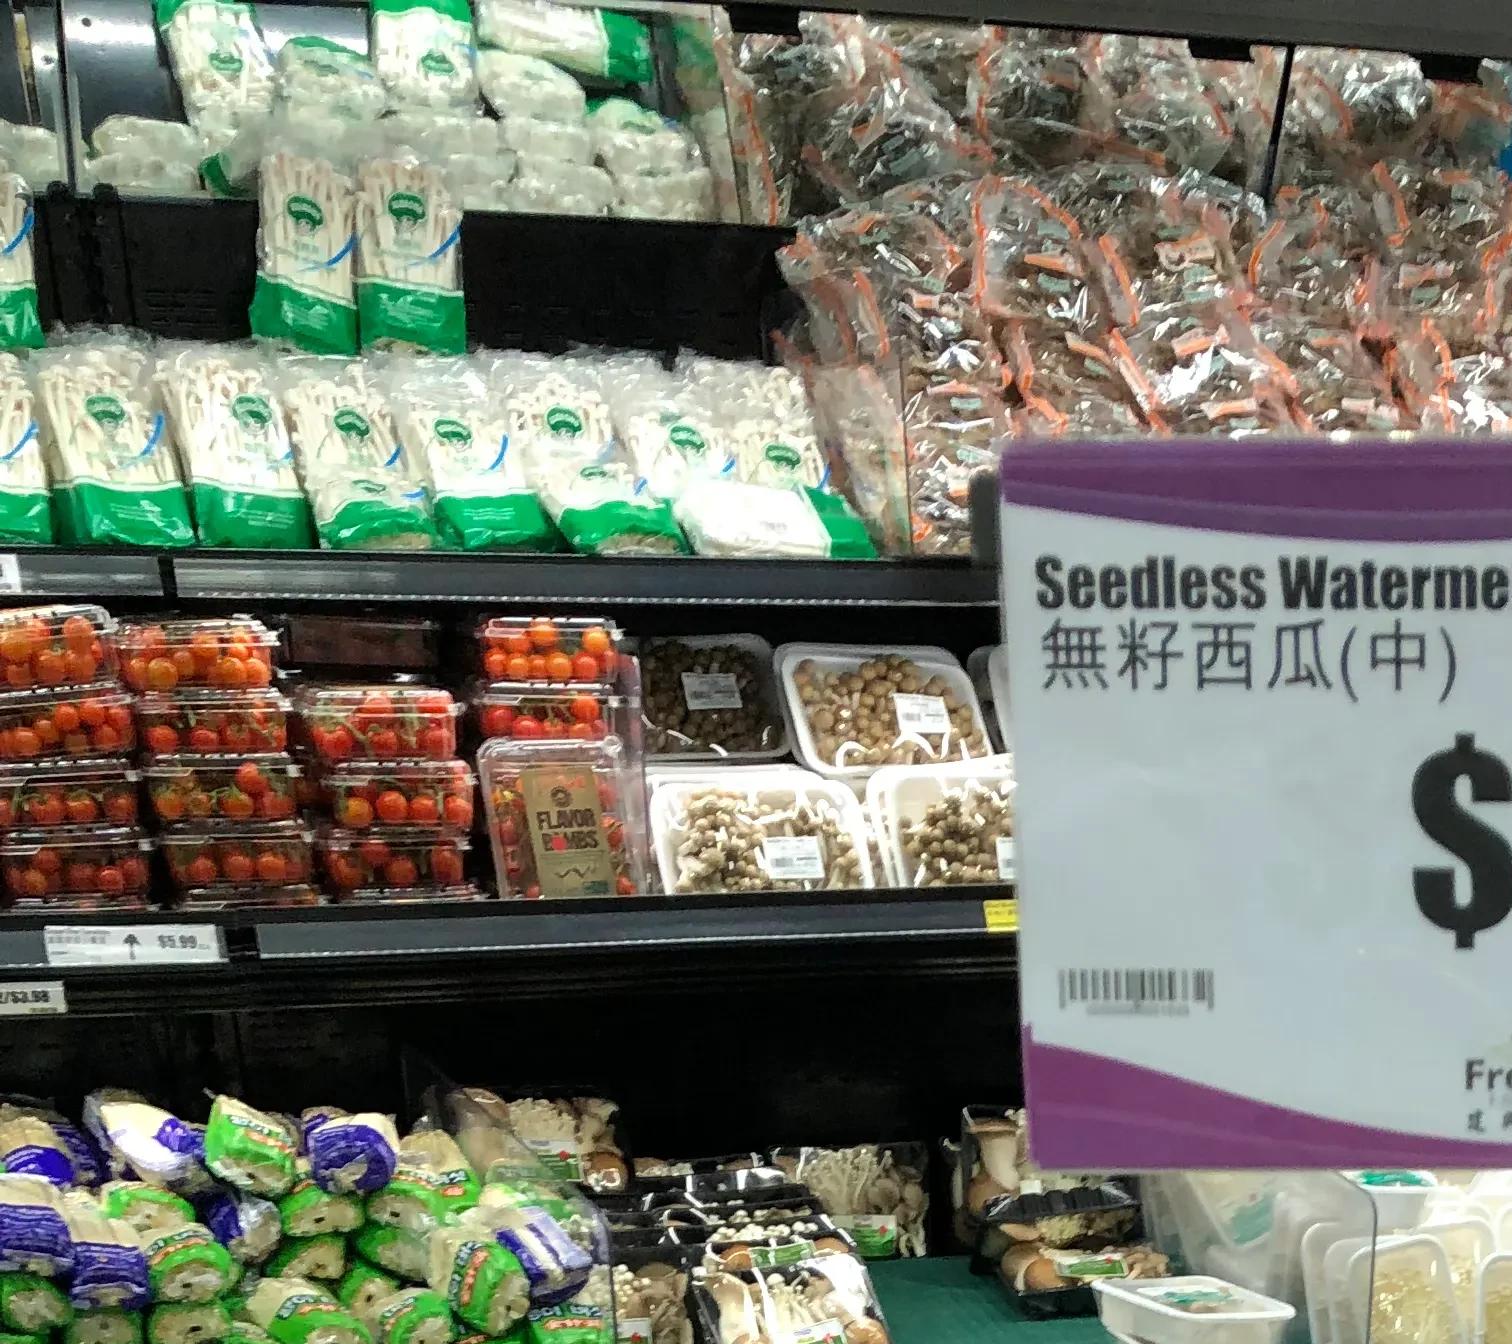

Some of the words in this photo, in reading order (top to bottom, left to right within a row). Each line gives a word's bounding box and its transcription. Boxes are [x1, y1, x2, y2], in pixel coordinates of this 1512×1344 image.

[1034, 554, 1268, 612] Seedless
[1041, 618, 1458, 704] 無籽西瓜(中)
[536, 808, 596, 830] FLAVOR
